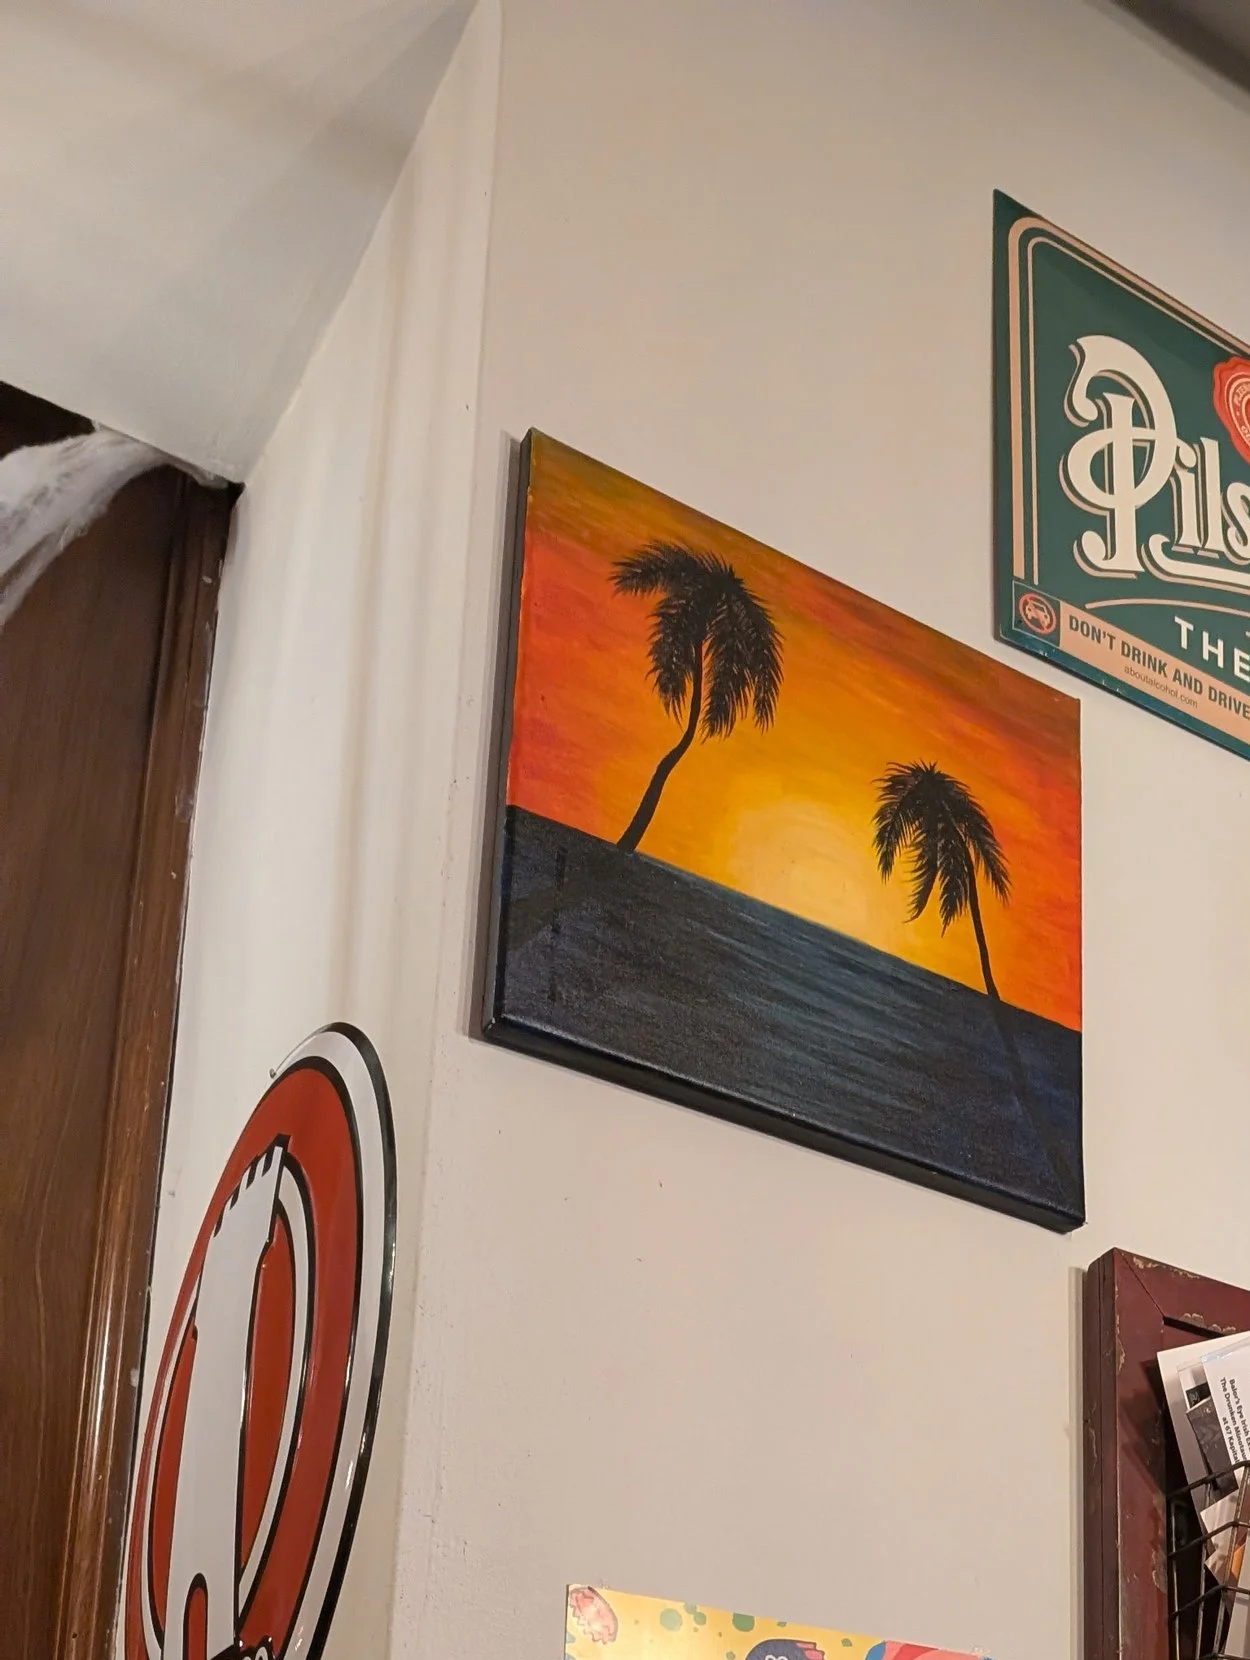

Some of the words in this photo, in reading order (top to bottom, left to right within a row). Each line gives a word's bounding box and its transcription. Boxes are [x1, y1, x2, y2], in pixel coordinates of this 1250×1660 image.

[1121, 640, 1168, 678] DRINK
[1172, 668, 1204, 695] AND
[1208, 686, 1250, 721] DRIVE
[1174, 615, 1250, 683] THE
[1225, 1393, 1236, 1426] Drunken
